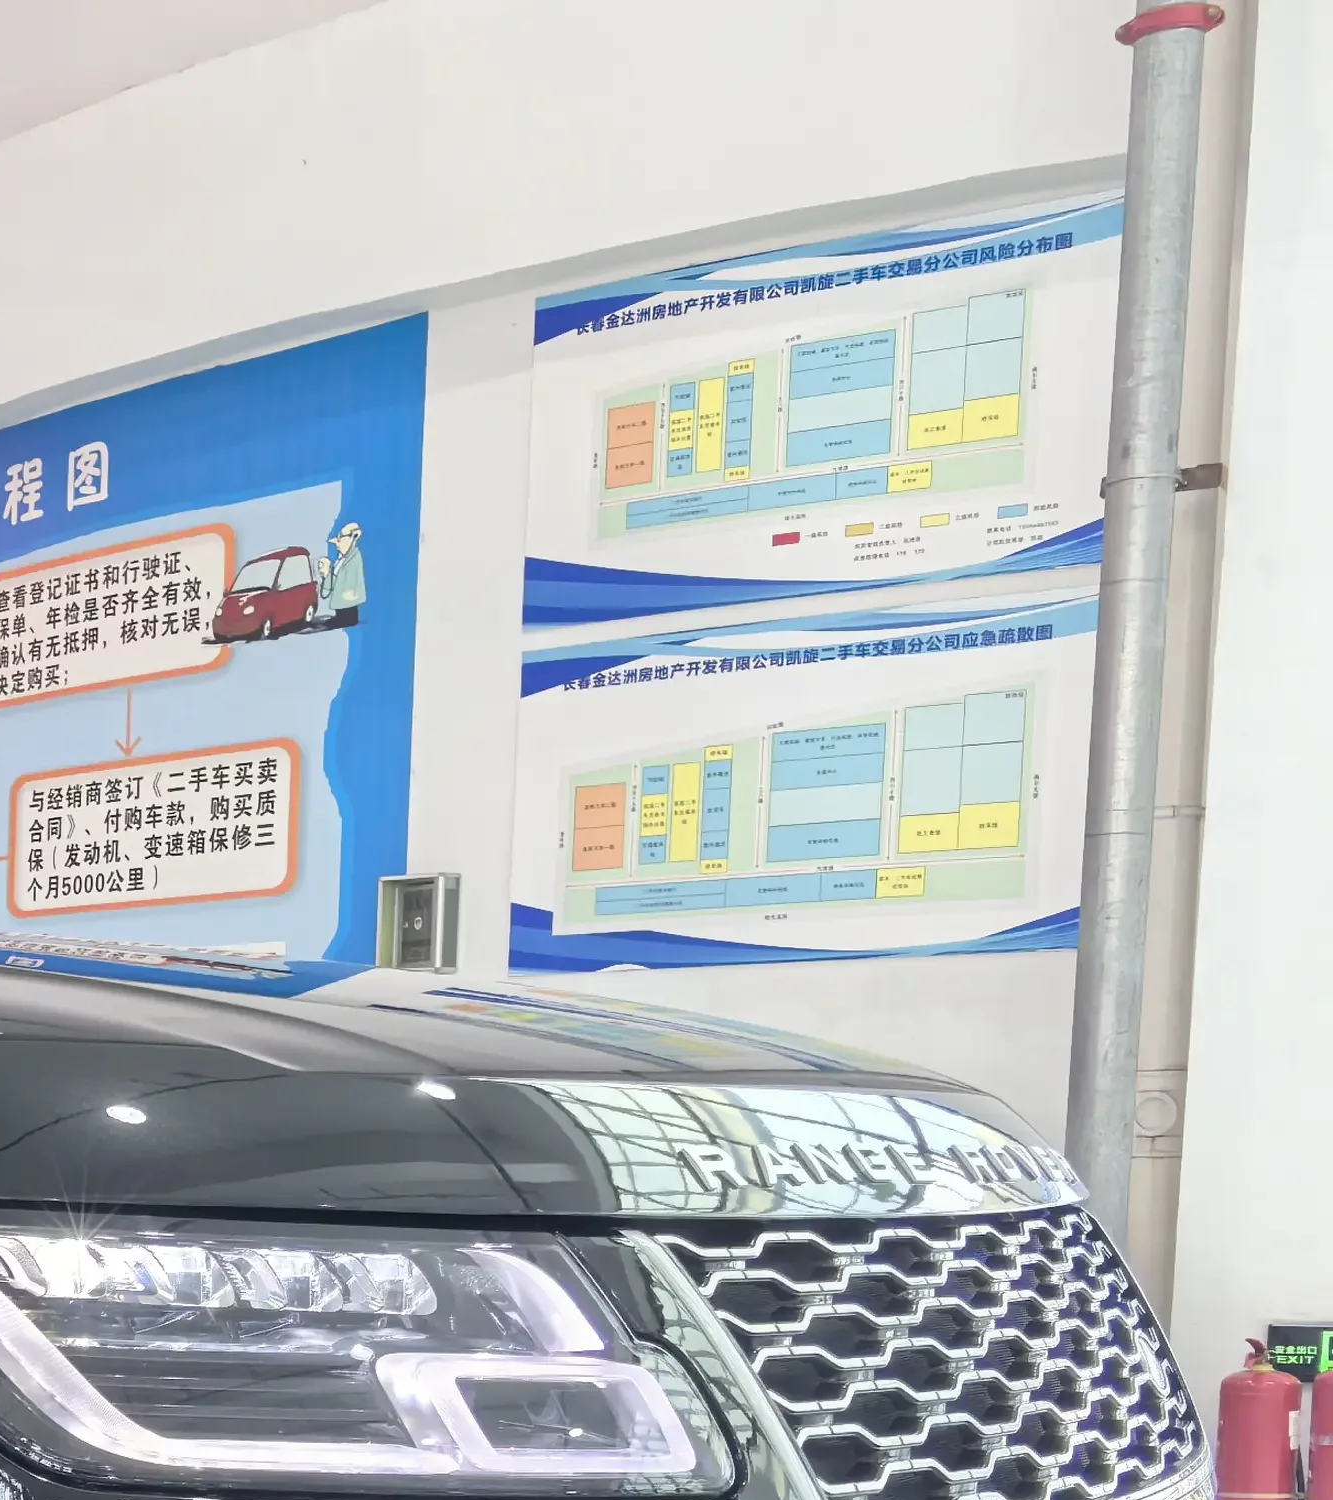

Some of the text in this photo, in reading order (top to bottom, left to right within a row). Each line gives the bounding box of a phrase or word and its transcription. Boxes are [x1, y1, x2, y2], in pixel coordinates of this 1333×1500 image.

[27, 757, 279, 814] 与经销商签订《二手车买卖
[27, 788, 278, 845] 合同》、付购车款，购买质
[27, 822, 277, 874] 保（发动机、变速箱保修三
[26, 864, 160, 903] 个月5000公里）
[677, 1142, 937, 1192] RANGE
[1276, 1355, 1315, 1364] EXIT
